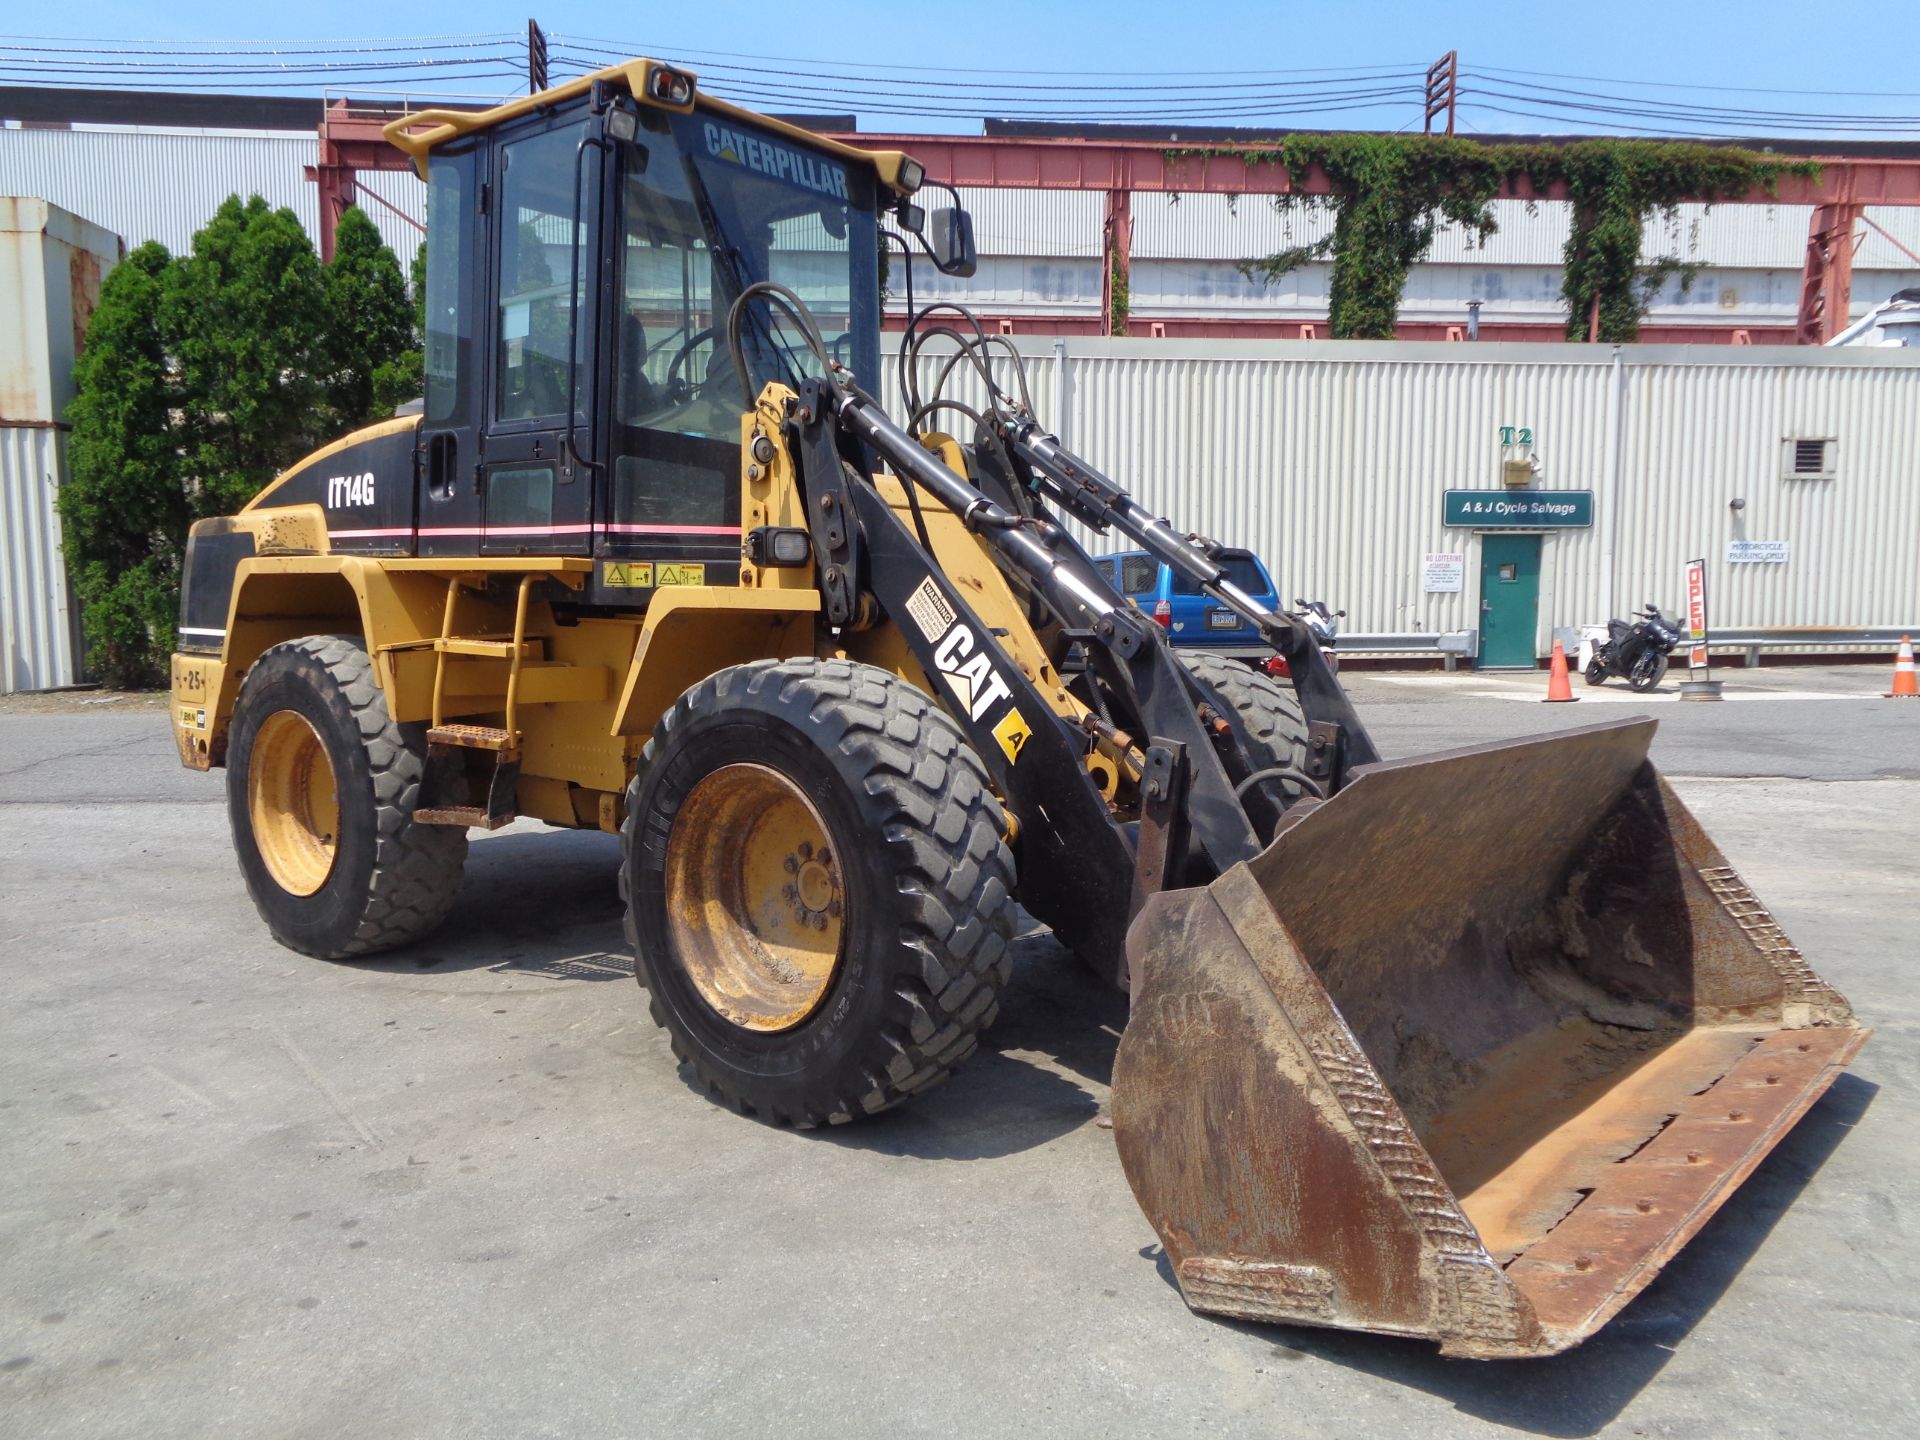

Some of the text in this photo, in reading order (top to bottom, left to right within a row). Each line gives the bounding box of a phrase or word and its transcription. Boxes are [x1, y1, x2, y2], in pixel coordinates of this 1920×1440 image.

[703, 122, 849, 201] CATERPILLAR
[328, 472, 375, 509] IT14G
[1462, 502, 1577, 515] A & J Cycle Salvage
[1732, 543, 1783, 551] MOTORCYCLE
[1425, 554, 1463, 563] NO LOITERING
[1766, 552, 1785, 560] ONLY
[925, 583, 951, 622] WARNING
[934, 623, 1012, 723] CAT
[1008, 732, 1024, 749] A
